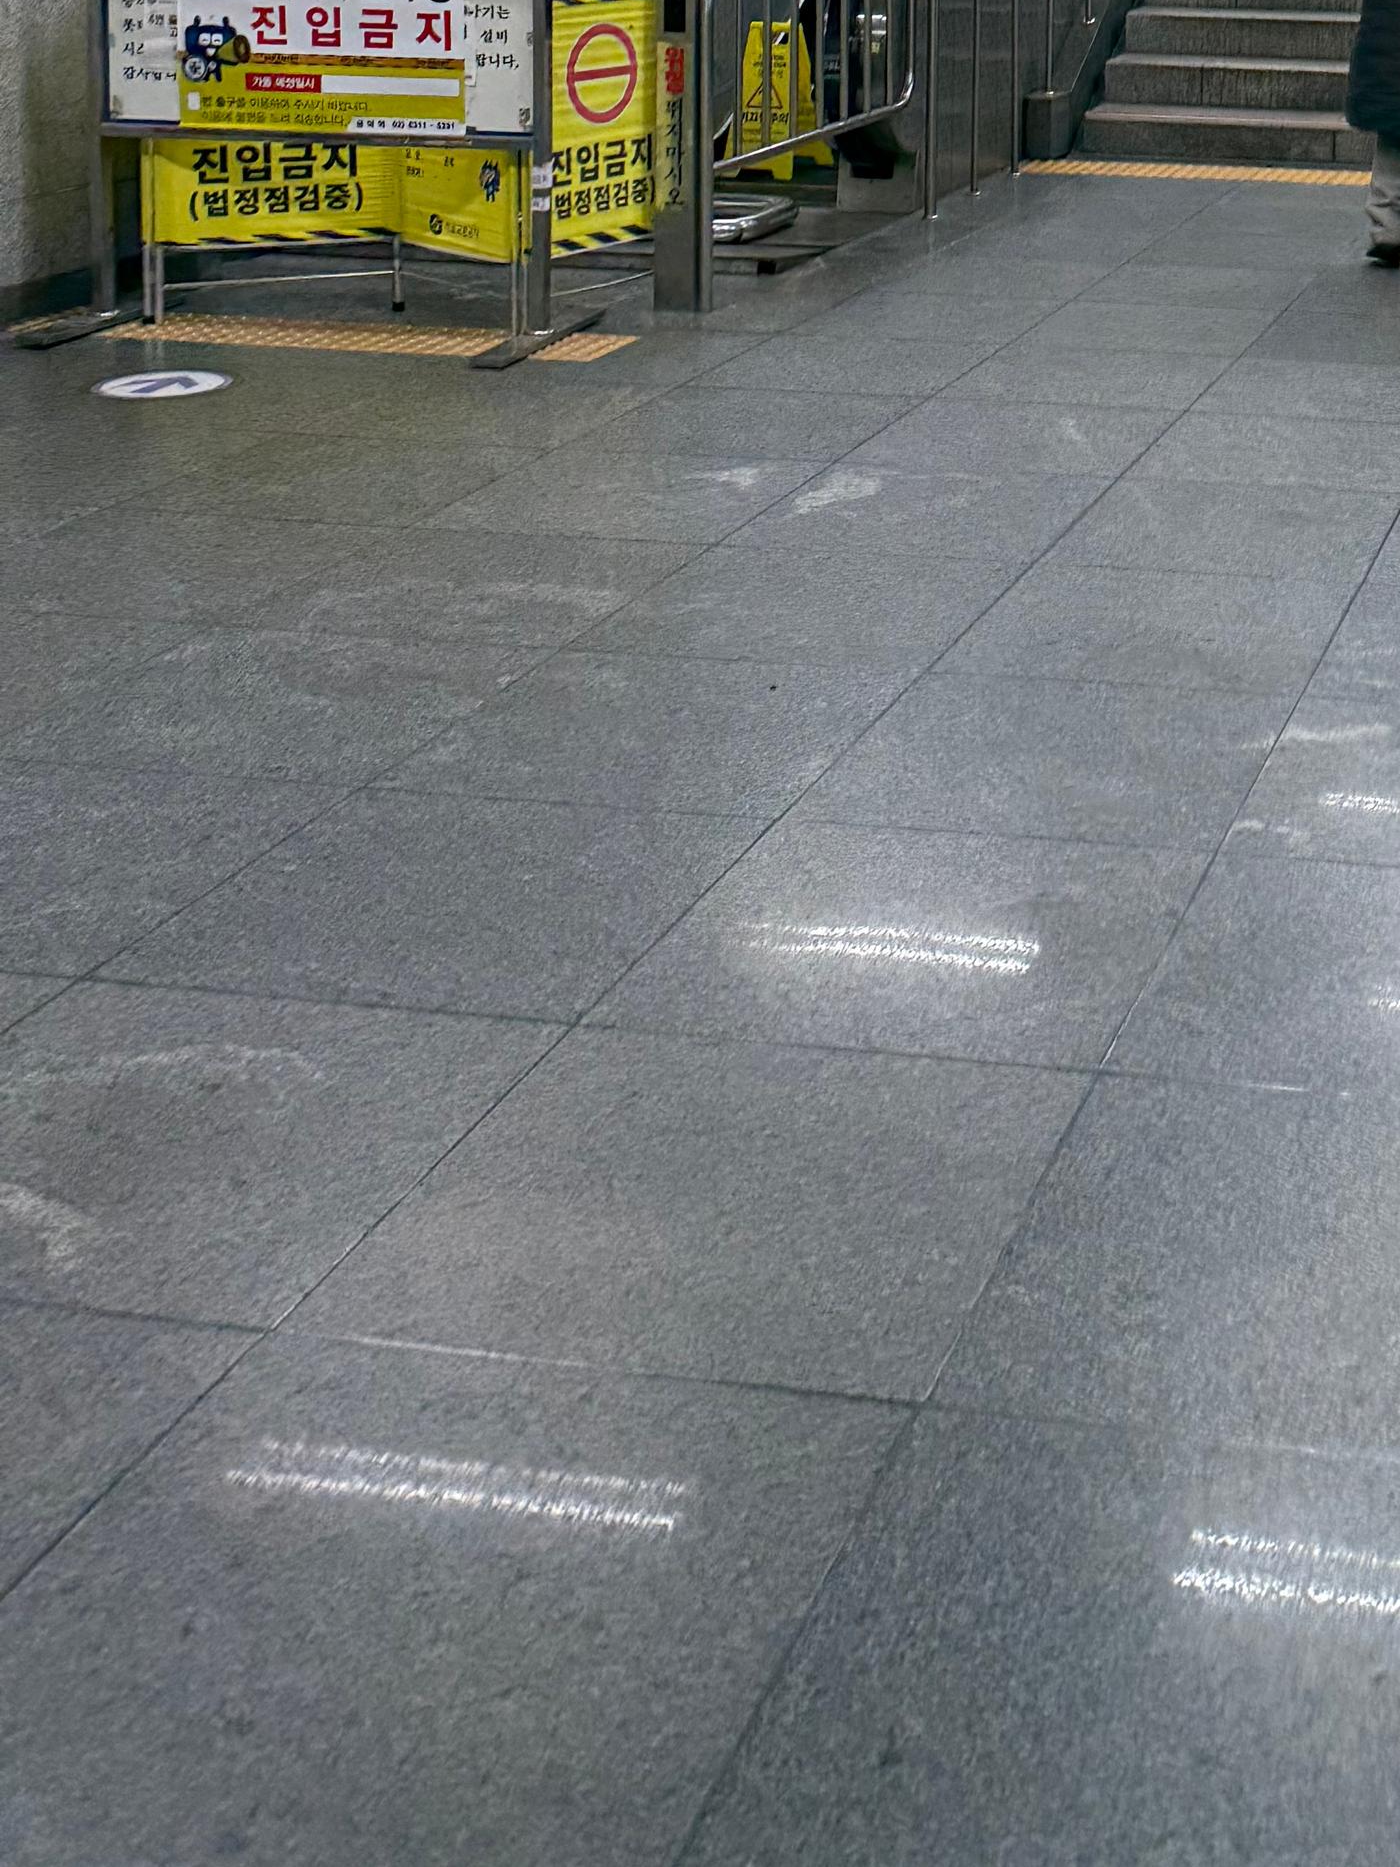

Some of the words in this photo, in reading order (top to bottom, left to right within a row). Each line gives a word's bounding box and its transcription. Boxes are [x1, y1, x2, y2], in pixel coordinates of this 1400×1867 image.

[250, 4, 453, 52] 진입금지
[192, 141, 358, 185] 진입금지
[551, 134, 653, 187] 진입금지
[189, 182, 364, 222] (법정점검중)
[554, 175, 655, 220] 법정점검중)
